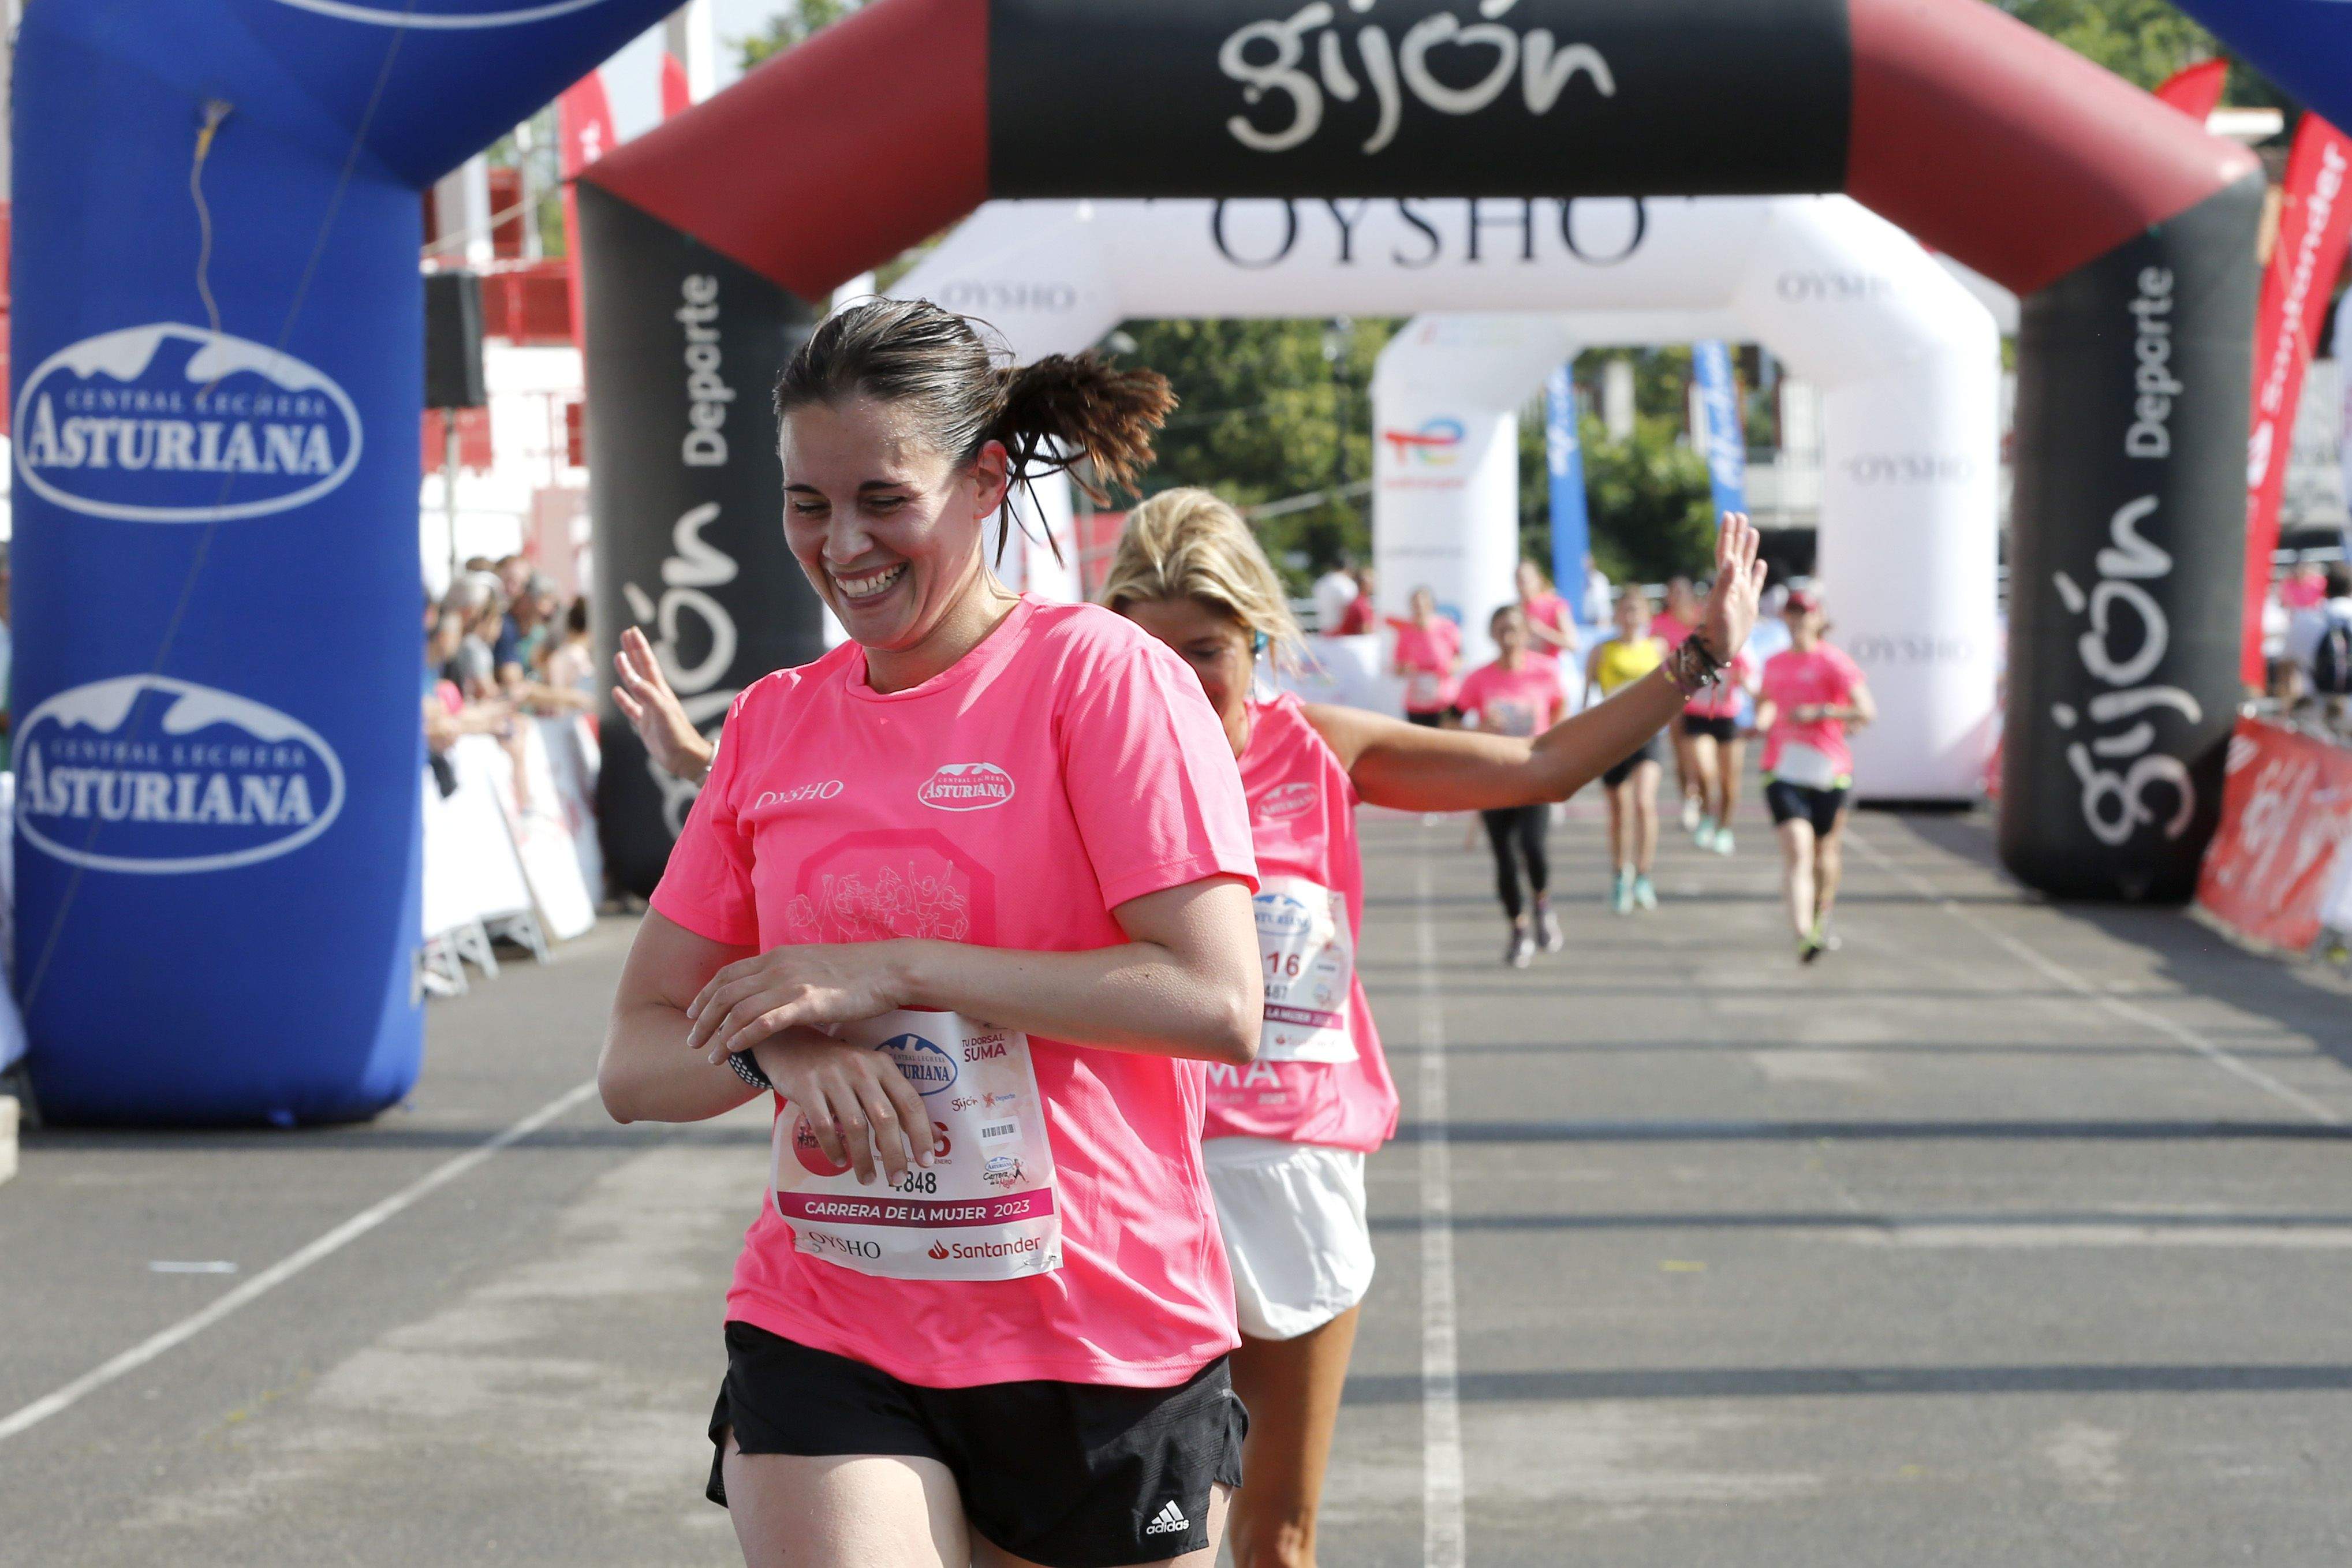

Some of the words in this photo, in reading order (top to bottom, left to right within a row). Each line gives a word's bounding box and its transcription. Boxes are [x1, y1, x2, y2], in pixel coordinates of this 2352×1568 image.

[1211, 197, 1648, 270] OYSHO
[676, 273, 737, 466] Deporte
[2125, 264, 2184, 460] Deporte
[65, 388, 182, 414] CENTRAL
[195, 393, 328, 417] LECHERA
[27, 391, 337, 475] ASTURIANA
[2051, 495, 2202, 845] gijón
[19, 742, 317, 826] ASTURIANA
[924, 781, 1007, 799] ASTURIANA
[962, 1039, 970, 1048] TU
[972, 1033, 1005, 1046] DORSAL
[964, 1043, 1007, 1062] SUMA
[951, 1096, 979, 1112] gijón
[889, 1171, 936, 1194] 848
[805, 1201, 881, 1218] CARRERA
[885, 1207, 908, 1220] DE
[910, 1208, 925, 1221] LA
[929, 1207, 986, 1221] MUJER
[994, 1199, 1030, 1218] 2023
[809, 1231, 881, 1259] OYSHO
[952, 1237, 1041, 1259] Santander
[1146, 1520, 1189, 1534] adidas
